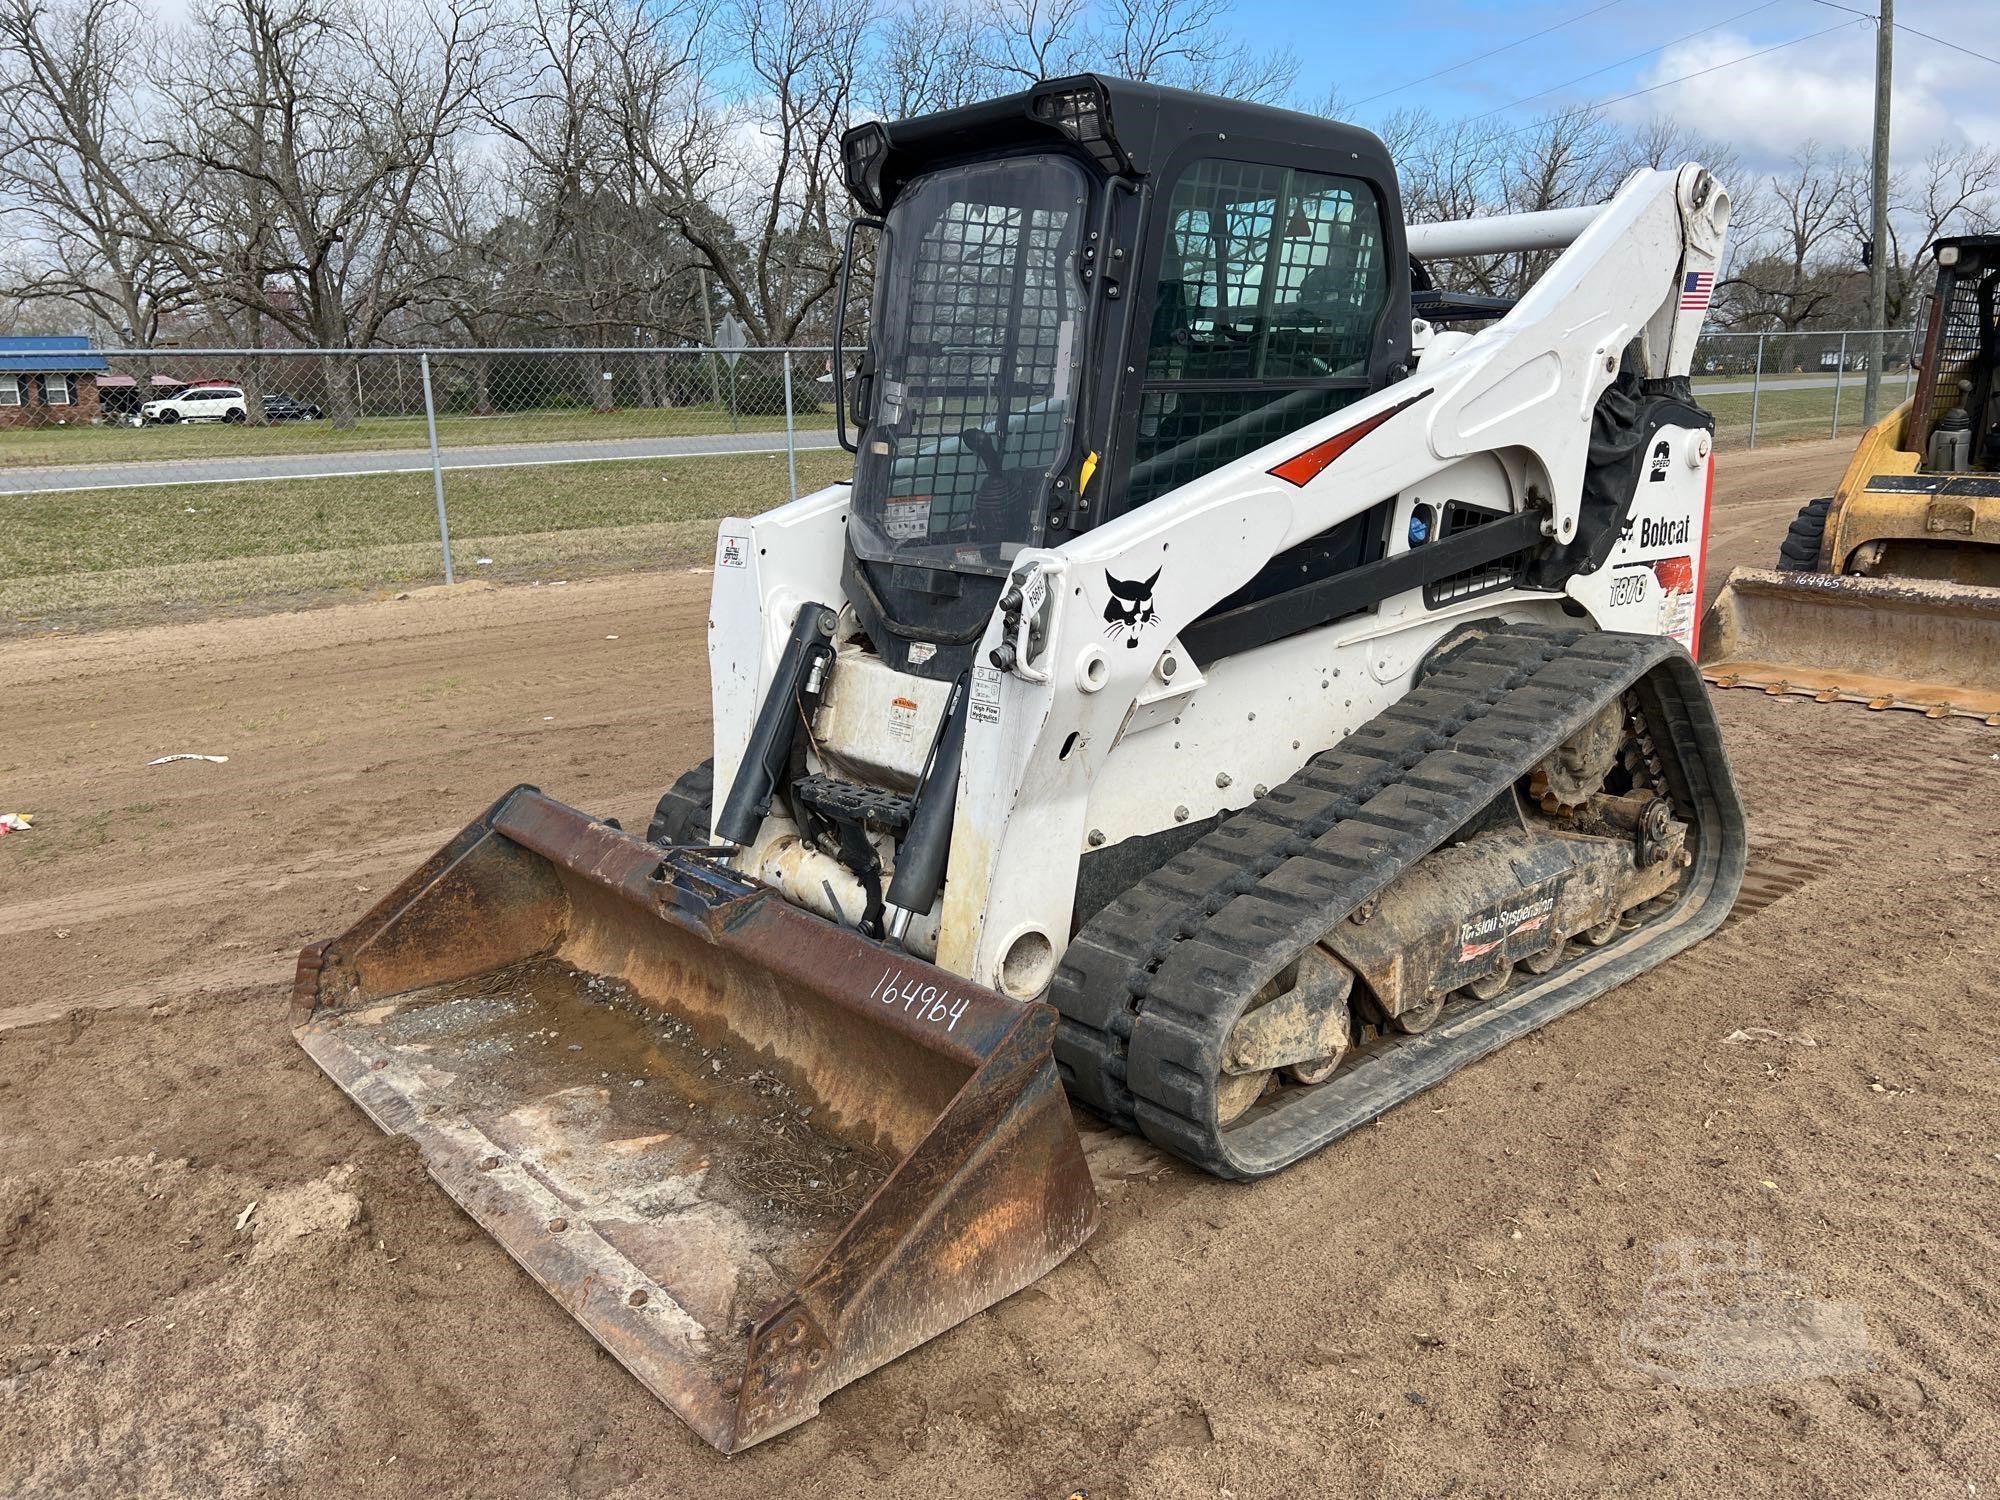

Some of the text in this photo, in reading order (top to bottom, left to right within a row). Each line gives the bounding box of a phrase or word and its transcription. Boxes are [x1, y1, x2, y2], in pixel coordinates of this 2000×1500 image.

[1649, 440, 1670, 482] 2
[1651, 459, 1670, 468] SPEED
[1640, 515, 1690, 548] Bobcat
[1795, 575, 1841, 589] 164965
[972, 711, 997, 721] Hydraulics
[870, 967, 970, 1032] 164964
